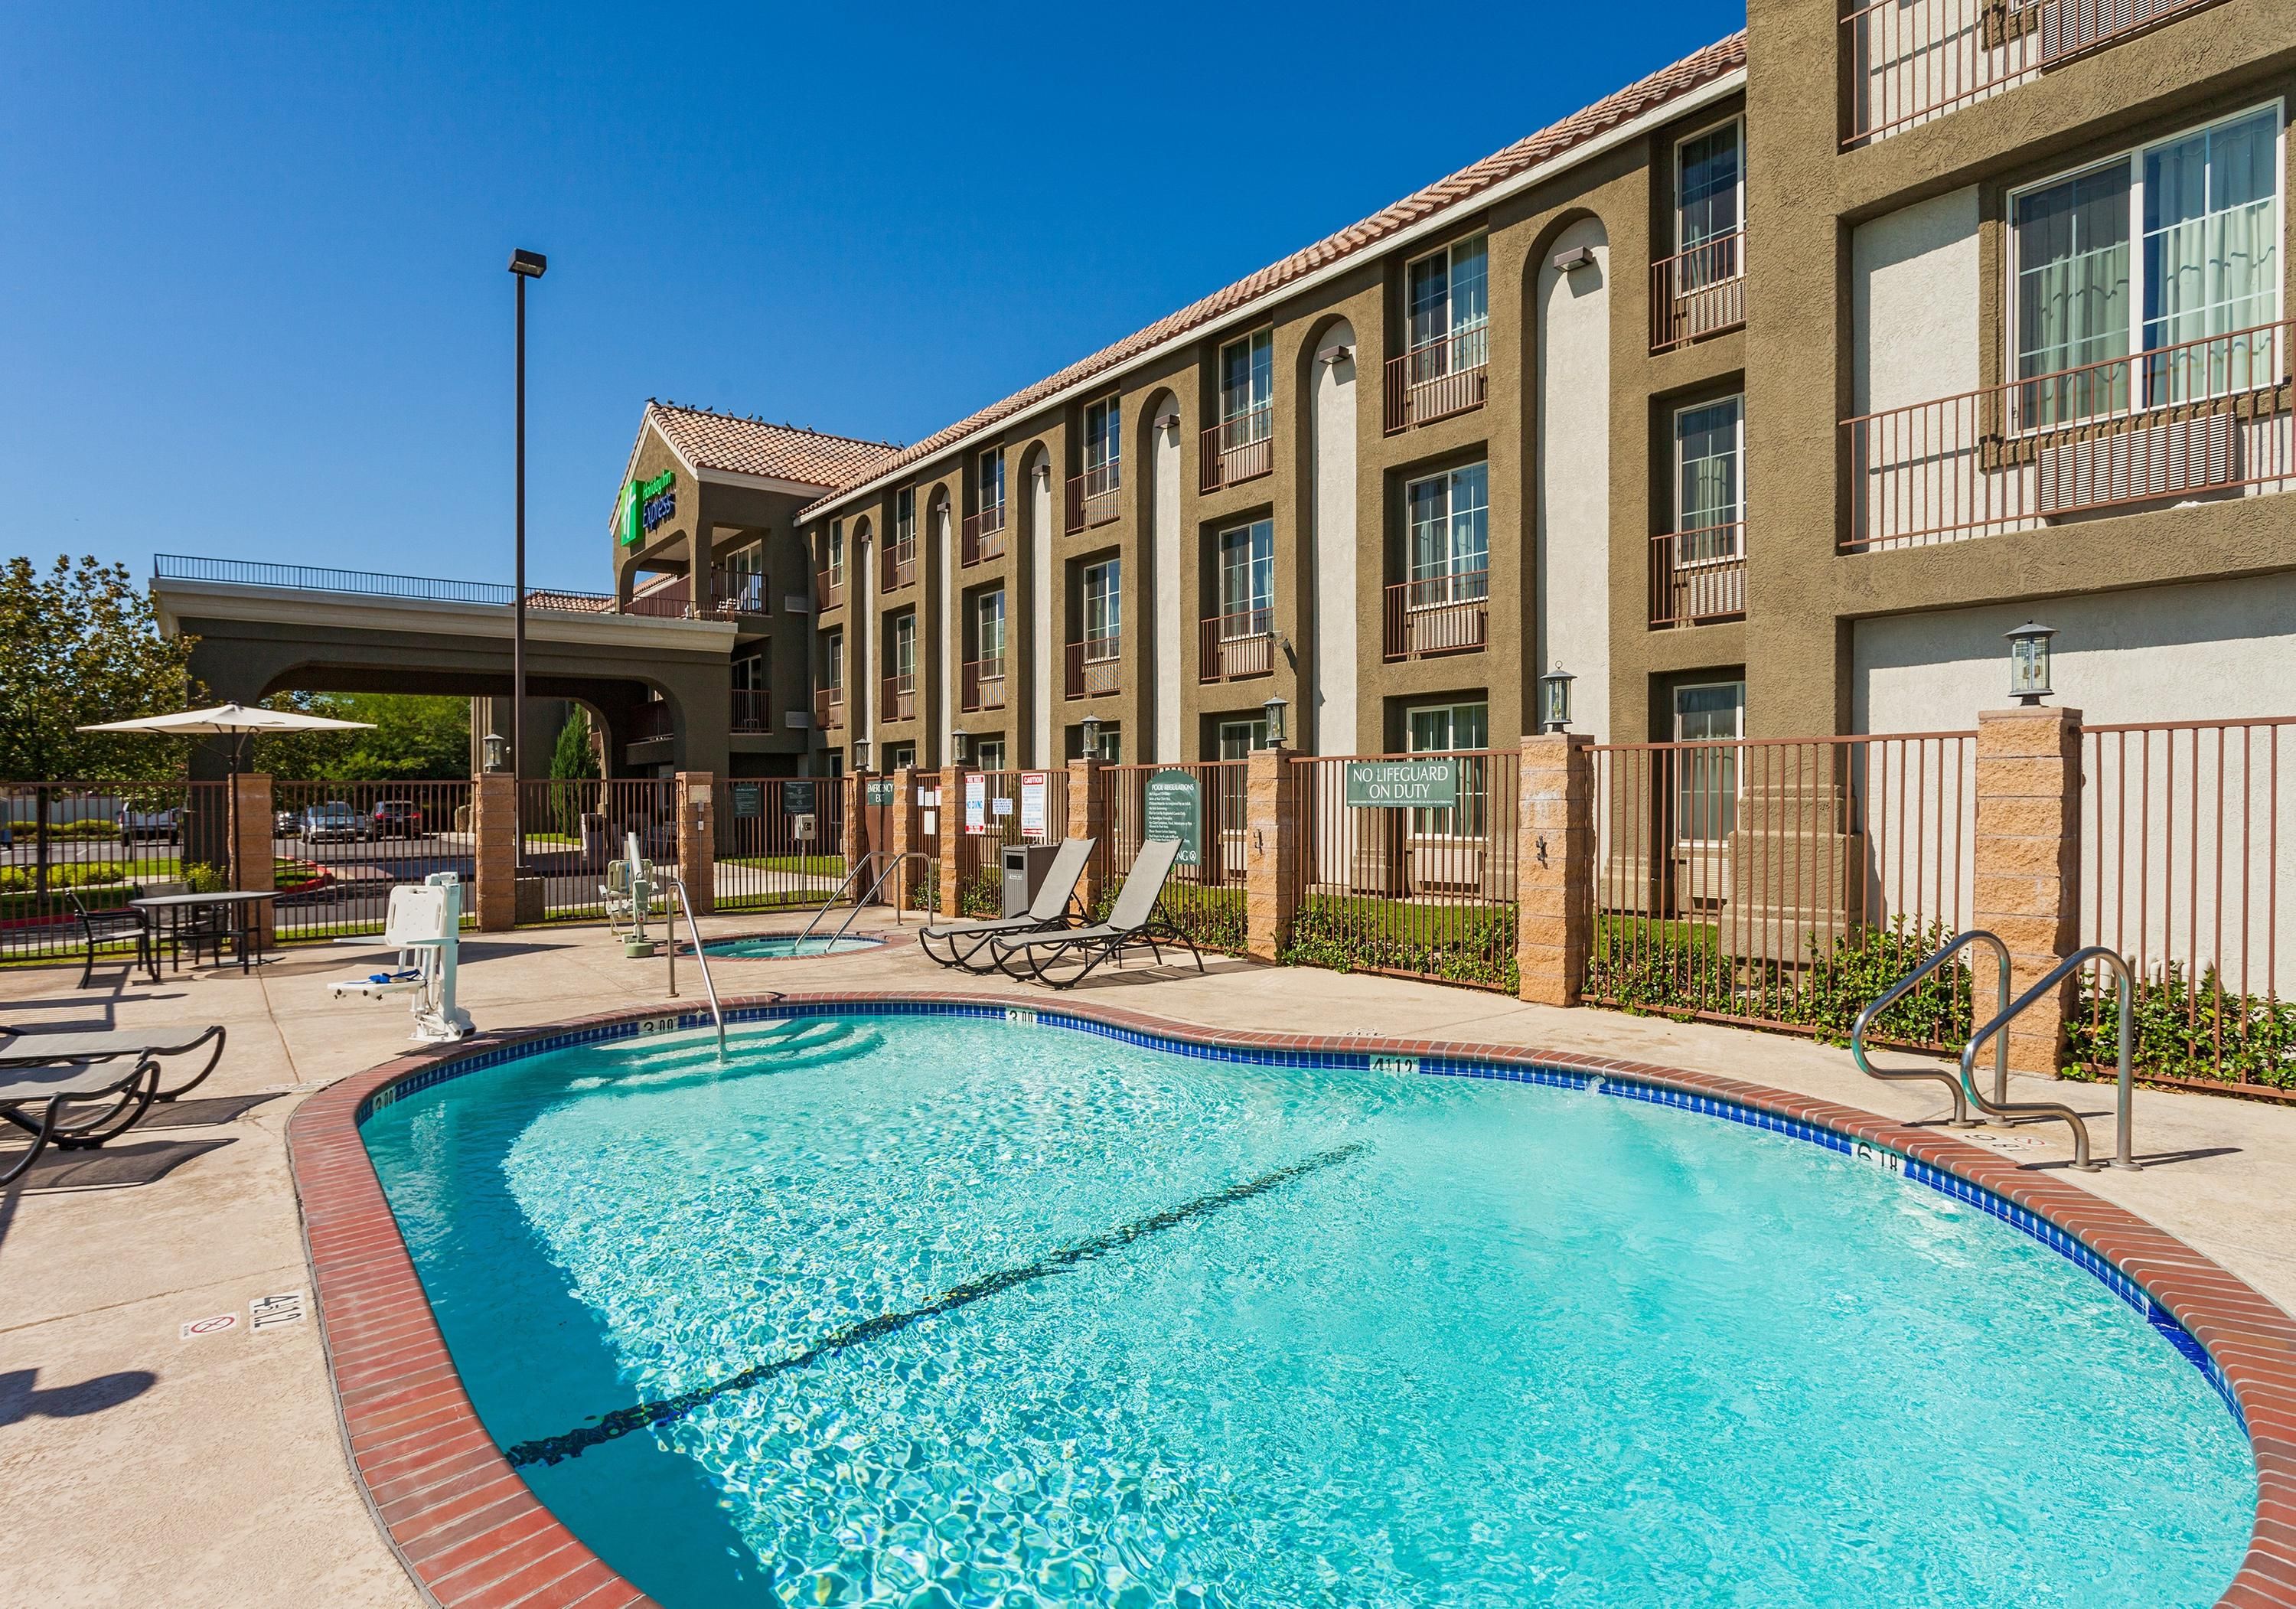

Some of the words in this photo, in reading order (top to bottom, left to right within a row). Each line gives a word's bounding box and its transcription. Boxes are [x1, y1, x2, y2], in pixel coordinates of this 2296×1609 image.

[662, 470, 671, 488] Inn
[643, 494, 671, 530] Express
[1023, 776, 1043, 785] CAUTION
[1353, 768, 1373, 782] NO
[1377, 765, 1449, 782] LIFEGUARD
[1369, 785, 1391, 798] ON
[1394, 783, 1430, 798] DUTY
